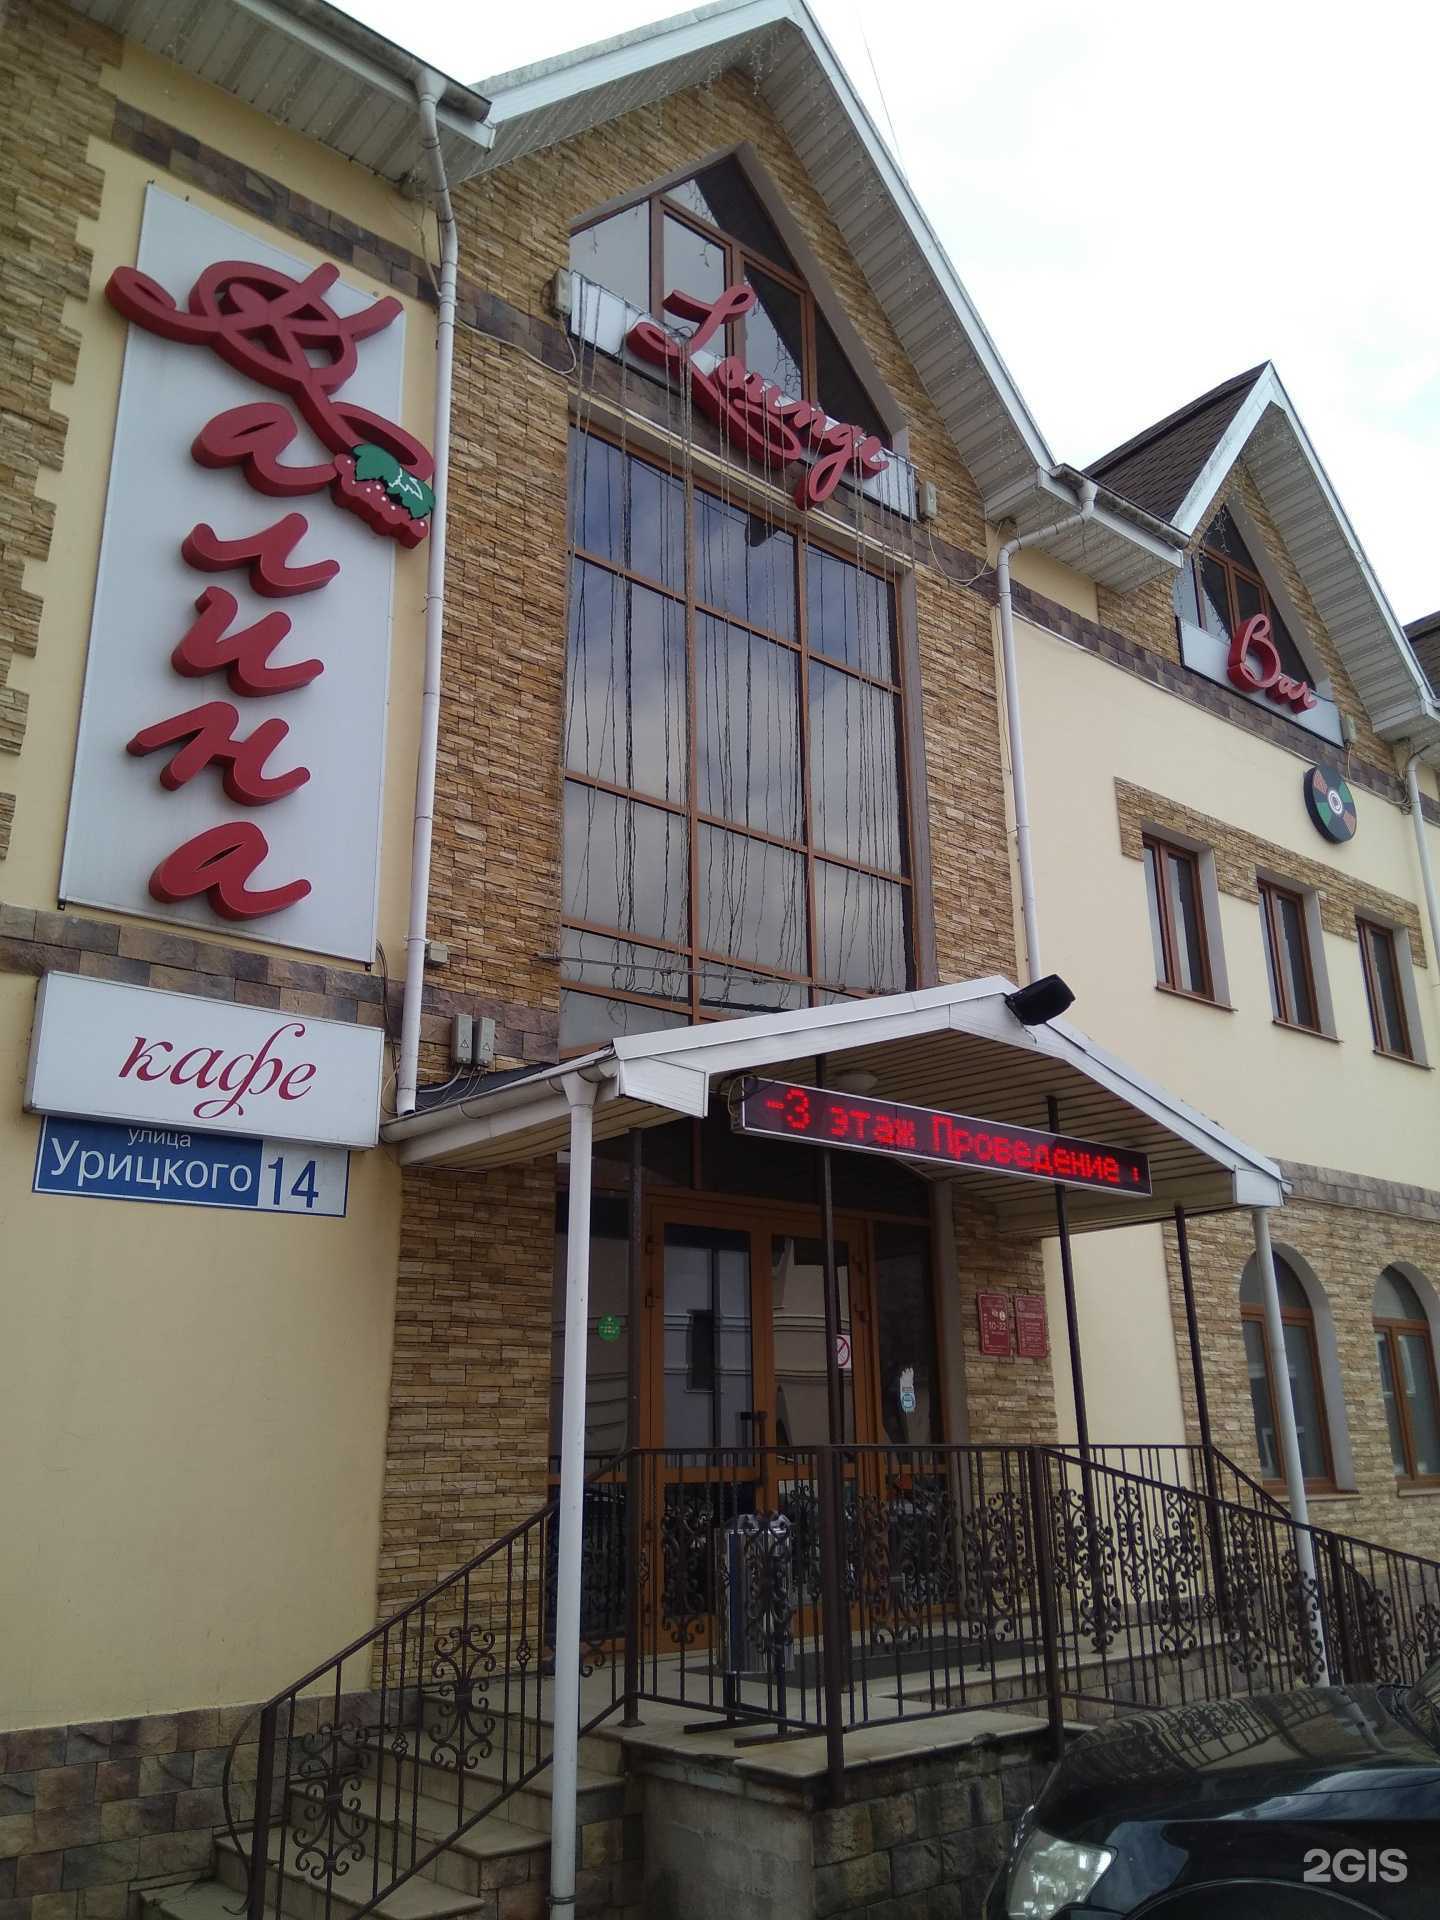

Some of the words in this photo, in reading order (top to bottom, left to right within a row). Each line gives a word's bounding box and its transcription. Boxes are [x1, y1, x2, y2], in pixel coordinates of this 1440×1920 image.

[626, 284, 890, 511] Lounge
[118, 1022, 317, 1119] кафе
[50, 1136, 253, 1193] Урицкого
[267, 1155, 320, 1209] 14
[127, 1126, 192, 1149] улица
[765, 1087, 812, 1131] -3
[830, 1106, 917, 1148] этаж
[930, 1114, 1121, 1183] Проведение
